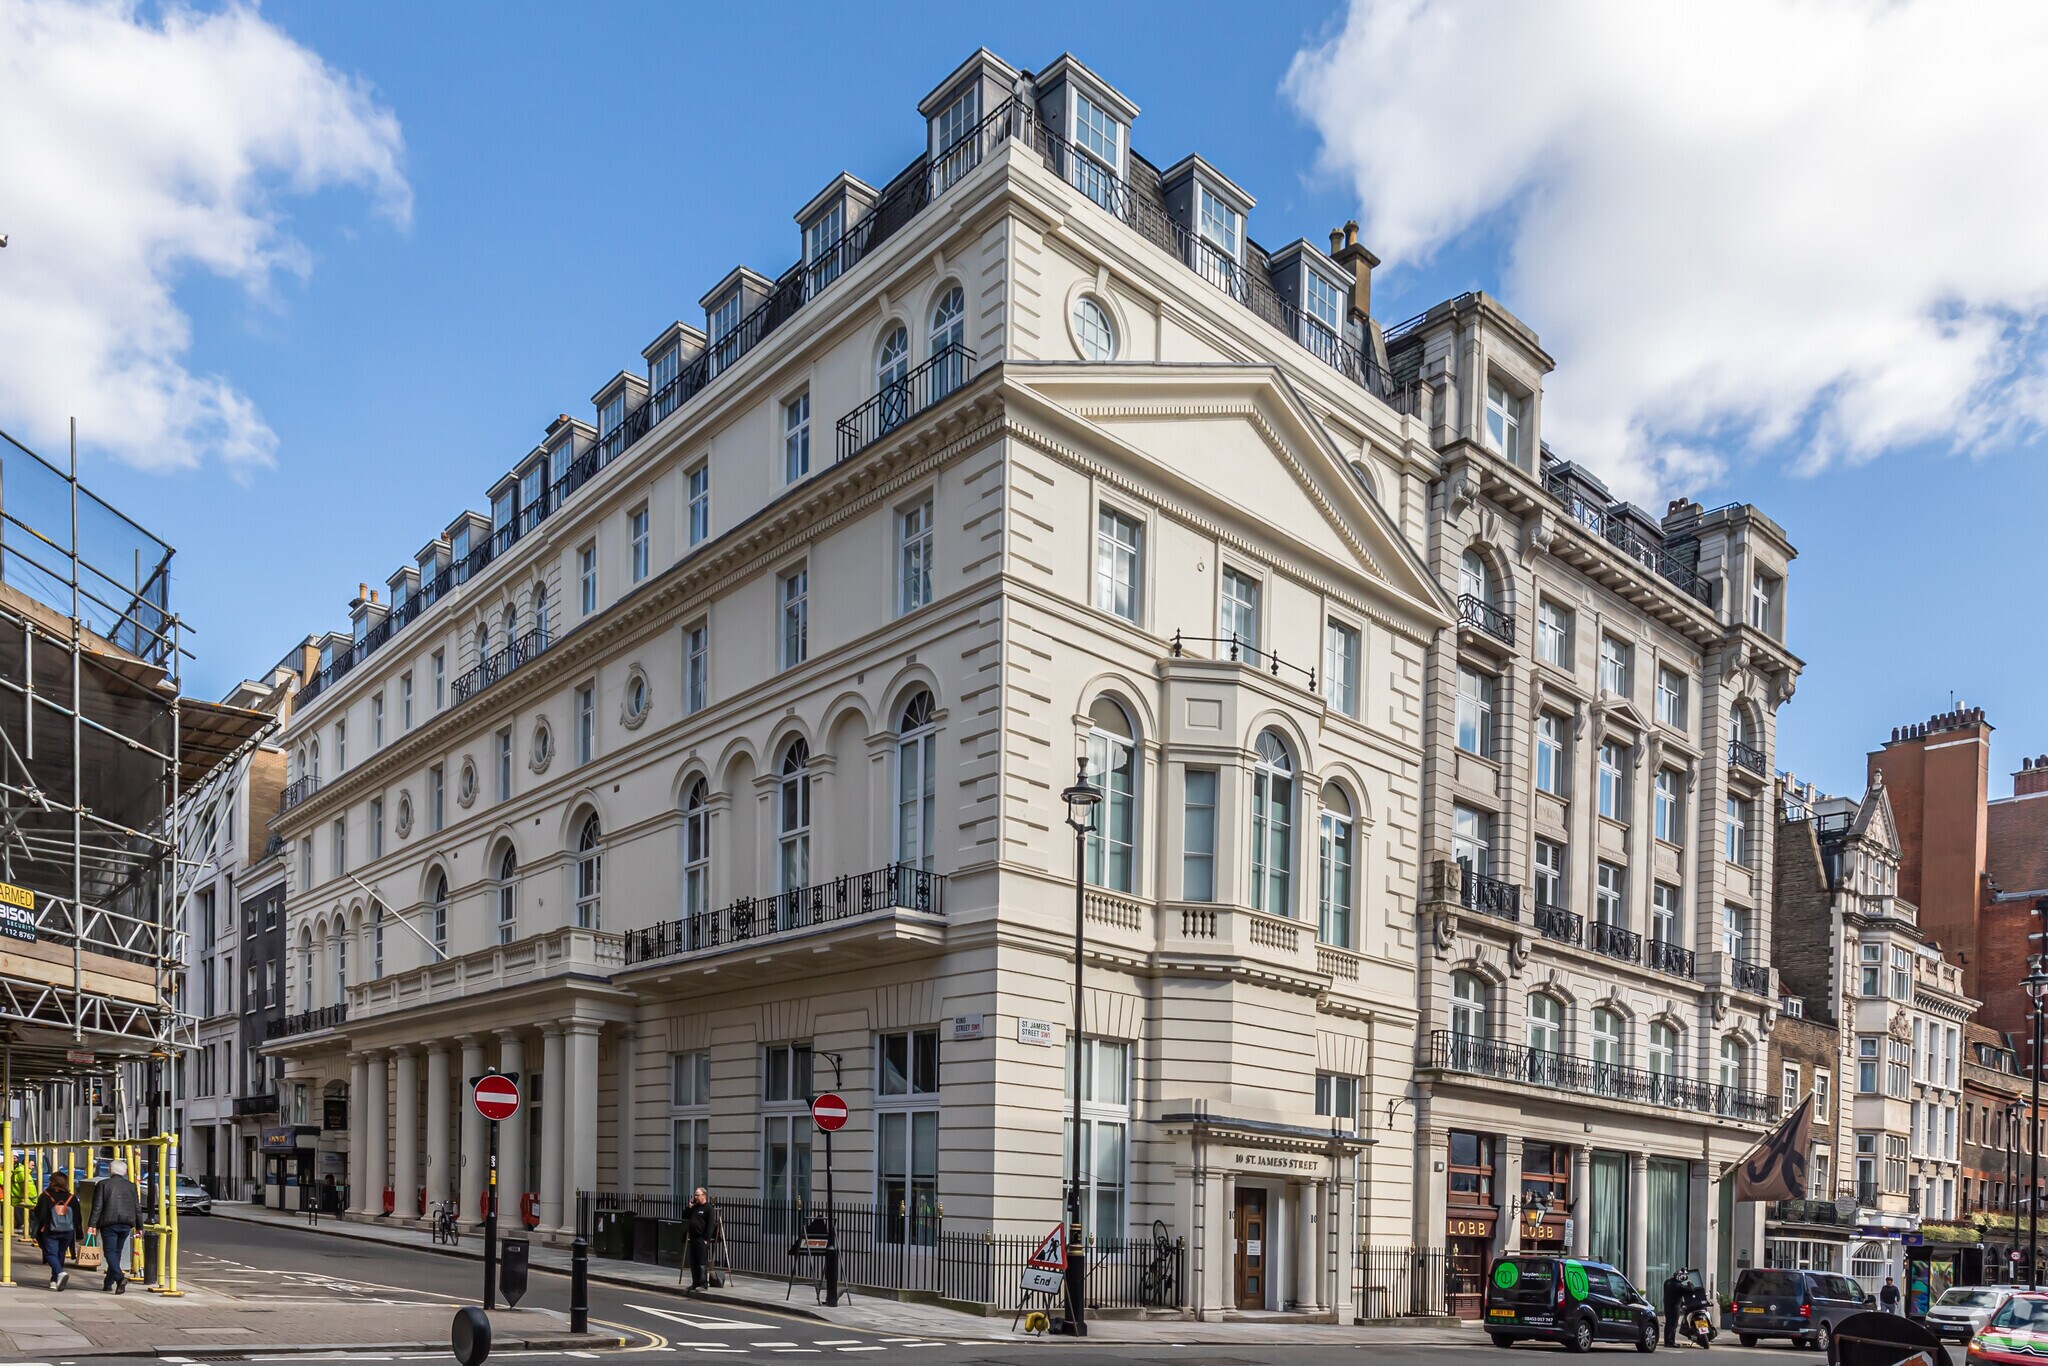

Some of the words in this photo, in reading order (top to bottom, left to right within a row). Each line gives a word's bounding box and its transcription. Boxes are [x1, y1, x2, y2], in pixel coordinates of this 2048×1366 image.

[0, 904, 35, 926] BISON
[5, 927, 17, 937] 112
[18, 931, 35, 940] 8767
[1021, 1029, 1039, 1038] STREET
[1236, 1154, 1243, 1163] 10
[1289, 1159, 1318, 1170] STREET
[1310, 1214, 1318, 1223] 10
[1449, 1220, 1486, 1236] LOBB
[1521, 1225, 1553, 1239] LOBB
[80, 1252, 100, 1260] F&M
[1034, 1275, 1052, 1286] End
